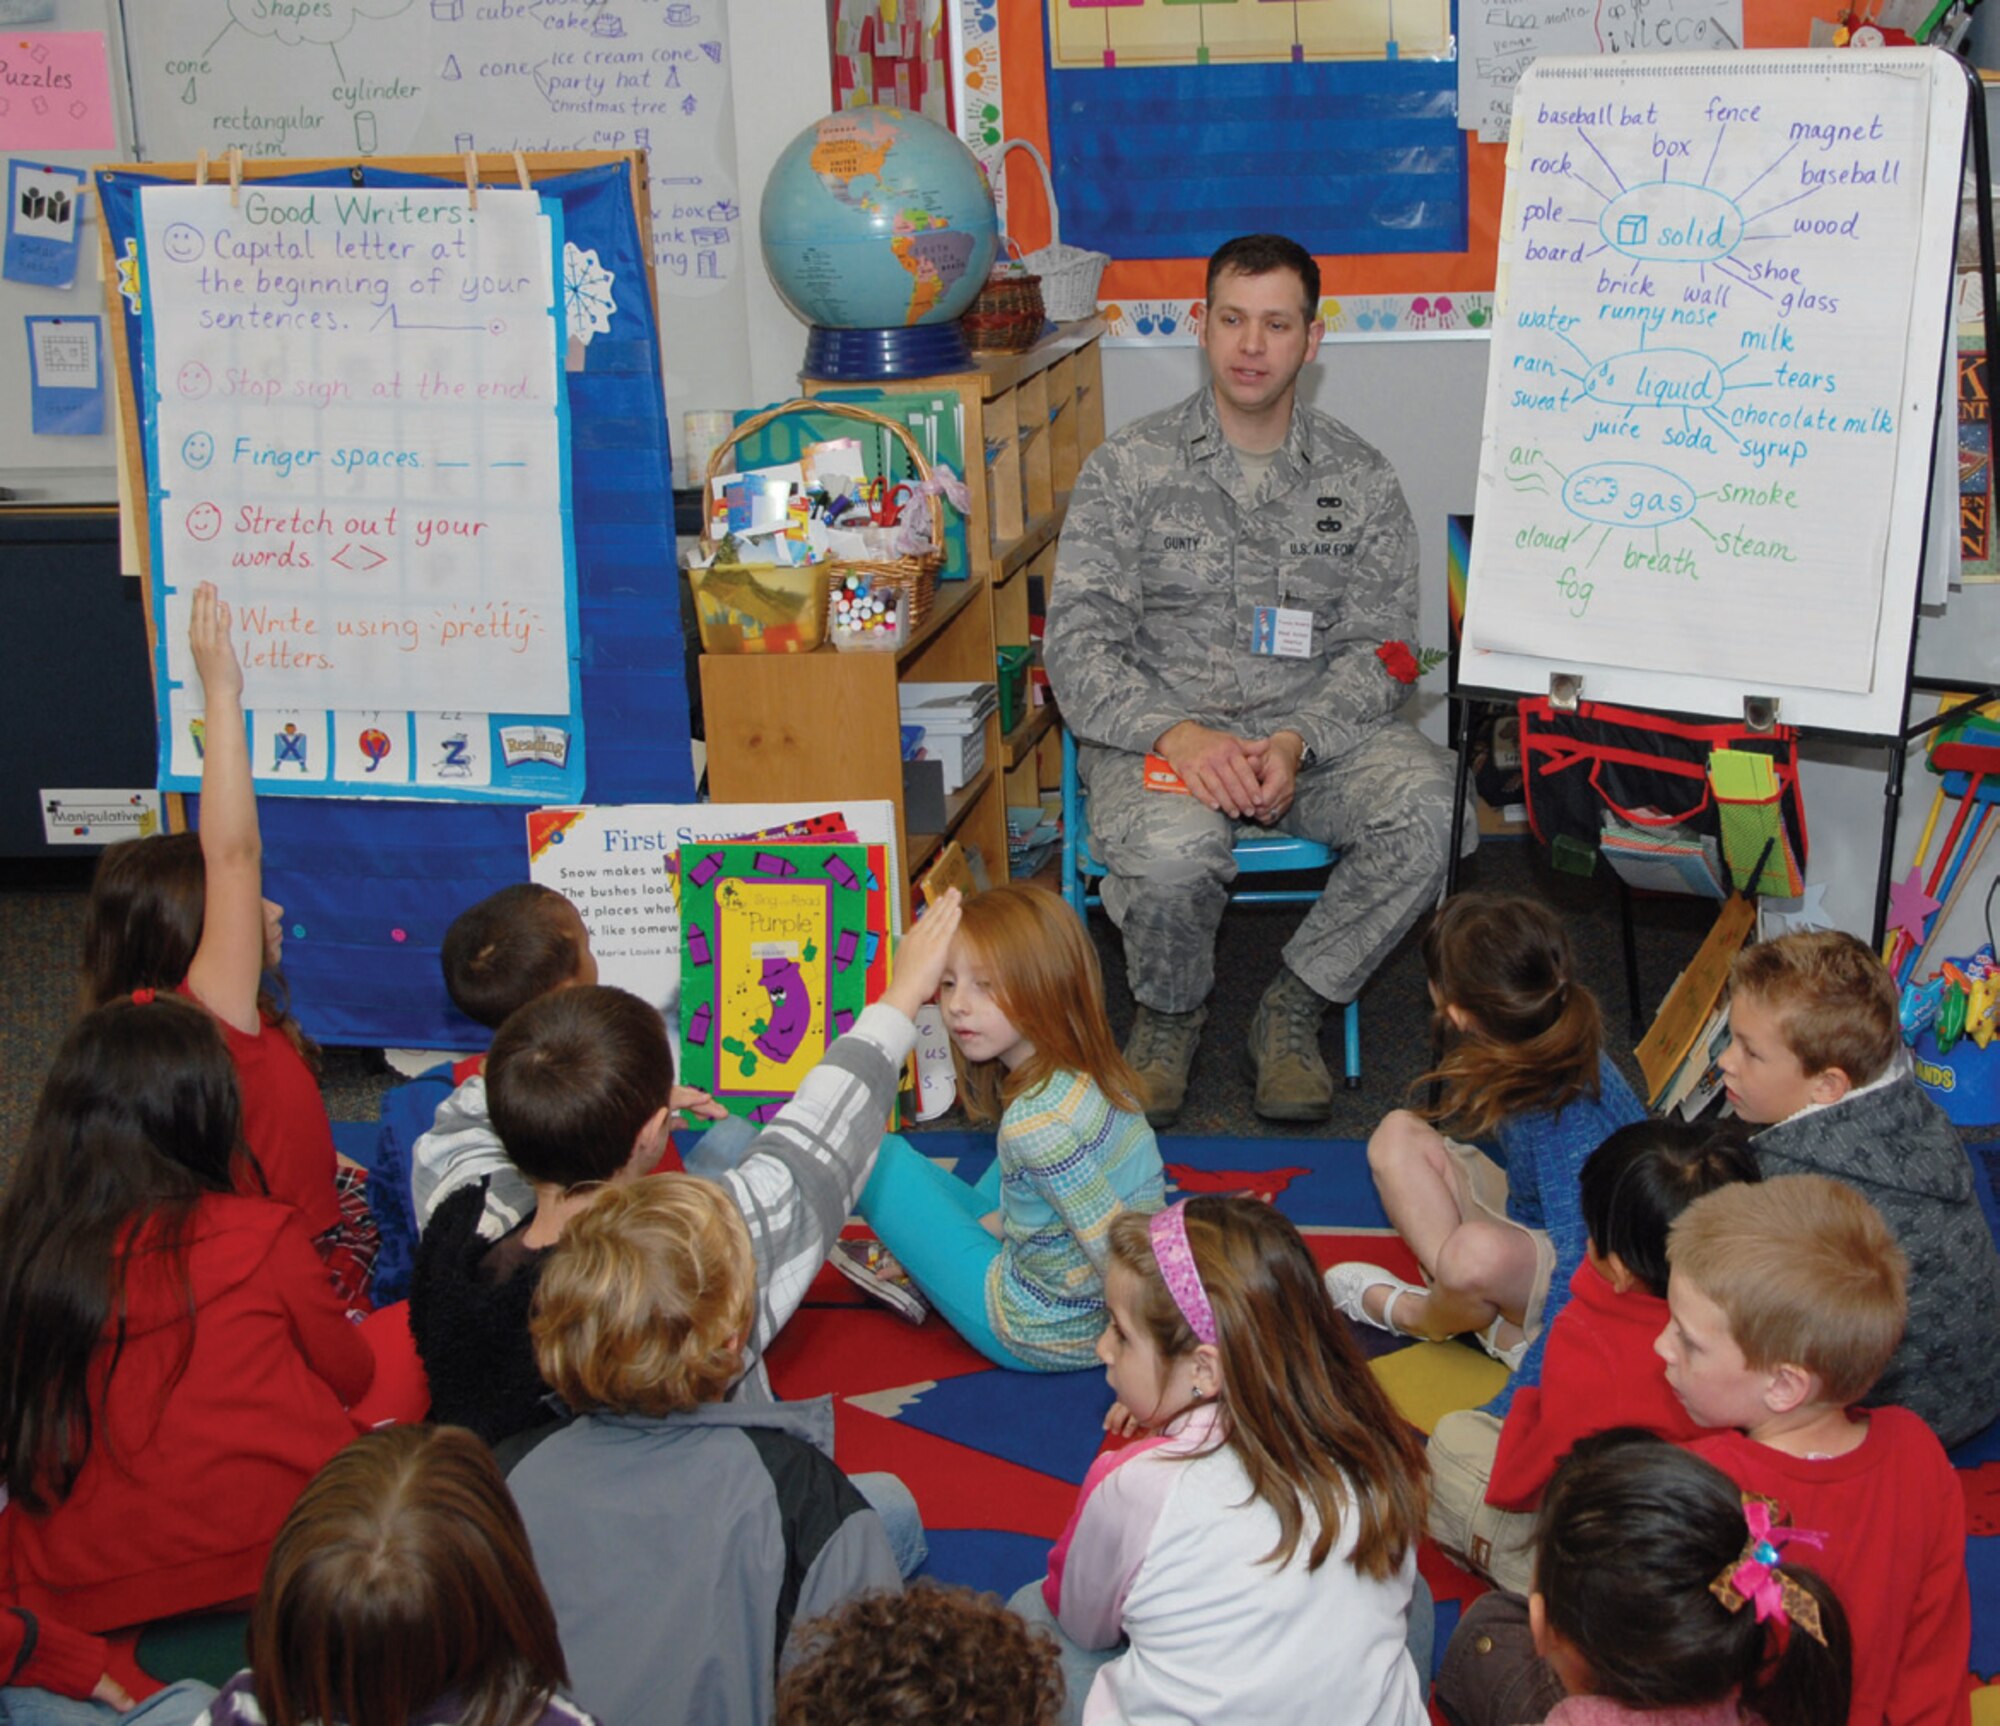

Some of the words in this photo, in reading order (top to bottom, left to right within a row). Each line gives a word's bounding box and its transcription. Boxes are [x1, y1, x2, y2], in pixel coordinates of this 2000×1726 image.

[250, 0, 333, 24] Shapes
[475, 3, 526, 21] cube
[165, 58, 212, 75] cone
[479, 61, 532, 77] cone
[584, 50, 643, 63] cream
[651, 48, 699, 63] cone
[0, 60, 73, 90] Puzzles
[549, 75, 605, 98] party
[616, 69, 651, 89] hat
[331, 76, 421, 110] cylinder
[631, 96, 668, 115] tree
[1537, 102, 1613, 127] baseball
[1620, 103, 1659, 128] bat
[1704, 96, 1761, 123] fence
[212, 106, 324, 144] rectangular
[1789, 115, 1884, 151] magnet
[592, 129, 626, 149] cup
[1652, 132, 1692, 158] box
[1530, 151, 1573, 178] rock
[1800, 160, 1900, 186] baseball
[245, 192, 321, 226] Good
[335, 195, 478, 226] Writers:
[1522, 197, 1564, 232] pole
[1658, 215, 1727, 249] solid
[1793, 211, 1860, 239] wood
[213, 228, 314, 266] Capital
[335, 230, 415, 260] letter
[430, 228, 467, 260] at
[1525, 240, 1586, 263] board
[1597, 272, 1656, 298] brick
[1748, 258, 1801, 285] shoe
[198, 266, 245, 295] the
[256, 267, 390, 308] beginning
[410, 267, 444, 295] of
[461, 276, 532, 303] your
[1683, 284, 1729, 309] wall
[199, 303, 350, 331] sentences.
[1781, 288, 1840, 319] glass
[1518, 306, 1581, 333] water
[1599, 304, 1666, 331] runny
[1671, 305, 1718, 328] nose
[1741, 323, 1794, 352] milk
[1513, 355, 1556, 376] rain
[223, 368, 283, 406] Stop
[295, 376, 351, 412] sign
[372, 369, 403, 398] at
[418, 367, 466, 400] the
[1636, 366, 1714, 408] liquid
[1775, 366, 1837, 393] tears
[1511, 387, 1570, 411] sweat
[1583, 416, 1641, 442] juice
[1731, 405, 1838, 435] chocolate
[1843, 408, 1893, 435] milk
[1663, 426, 1718, 455] soda
[1739, 438, 1808, 469] syrup
[232, 436, 322, 478] Finger
[1509, 446, 1543, 465] air
[1622, 489, 1684, 520] gas
[1717, 481, 1800, 509] smoke
[234, 505, 335, 536] Stretch
[344, 506, 399, 536] out
[417, 519, 490, 547] your
[1515, 527, 1572, 552] cloud
[1163, 536, 1201, 551] GUNTY
[1289, 543, 1310, 556] U.S.
[1313, 543, 1334, 556] AIR
[1715, 523, 1797, 562] steam
[1624, 543, 1700, 581] breath
[1556, 566, 1595, 618] fog
[238, 605, 320, 636] Write
[336, 616, 420, 652] using
[440, 609, 535, 655] pretty
[242, 640, 336, 672] letters.
[506, 734, 565, 759] Reading
[53, 810, 149, 826] Manipulatives
[603, 829, 668, 853] First
[560, 867, 598, 880] Snow
[602, 865, 646, 877] makes
[561, 887, 586, 899] The
[590, 884, 638, 898] bushes
[642, 883, 672, 895] look
[594, 904, 639, 919] places
[644, 904, 677, 916] wher
[601, 924, 626, 937] like
[631, 924, 679, 936] somew
[1916, 1060, 1954, 1089] ANDS
